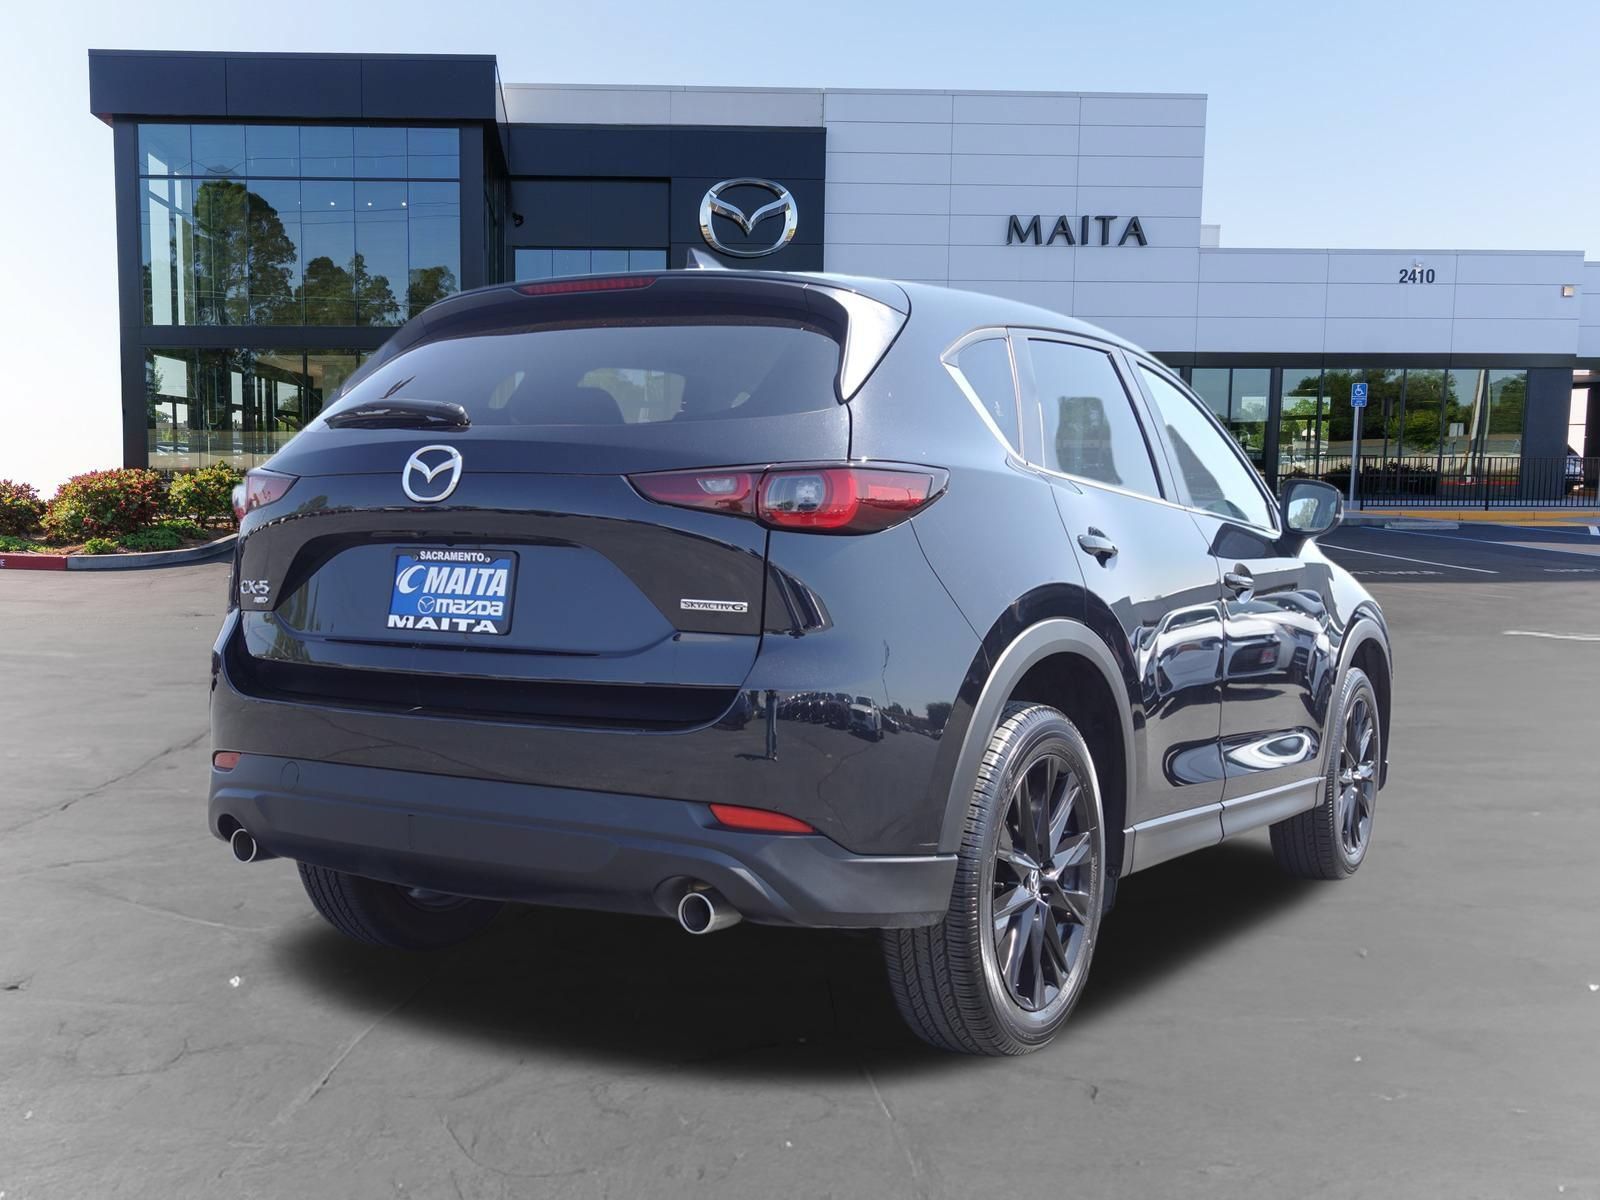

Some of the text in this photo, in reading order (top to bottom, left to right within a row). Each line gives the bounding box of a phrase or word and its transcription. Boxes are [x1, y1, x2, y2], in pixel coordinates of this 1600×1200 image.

[1006, 214, 1148, 246] MAITA
[1399, 268, 1436, 284] 2410
[419, 550, 485, 562] SACRAMENTO
[240, 580, 269, 594] CX-5
[422, 566, 508, 596] MAITA
[387, 614, 498, 633] MAITA
